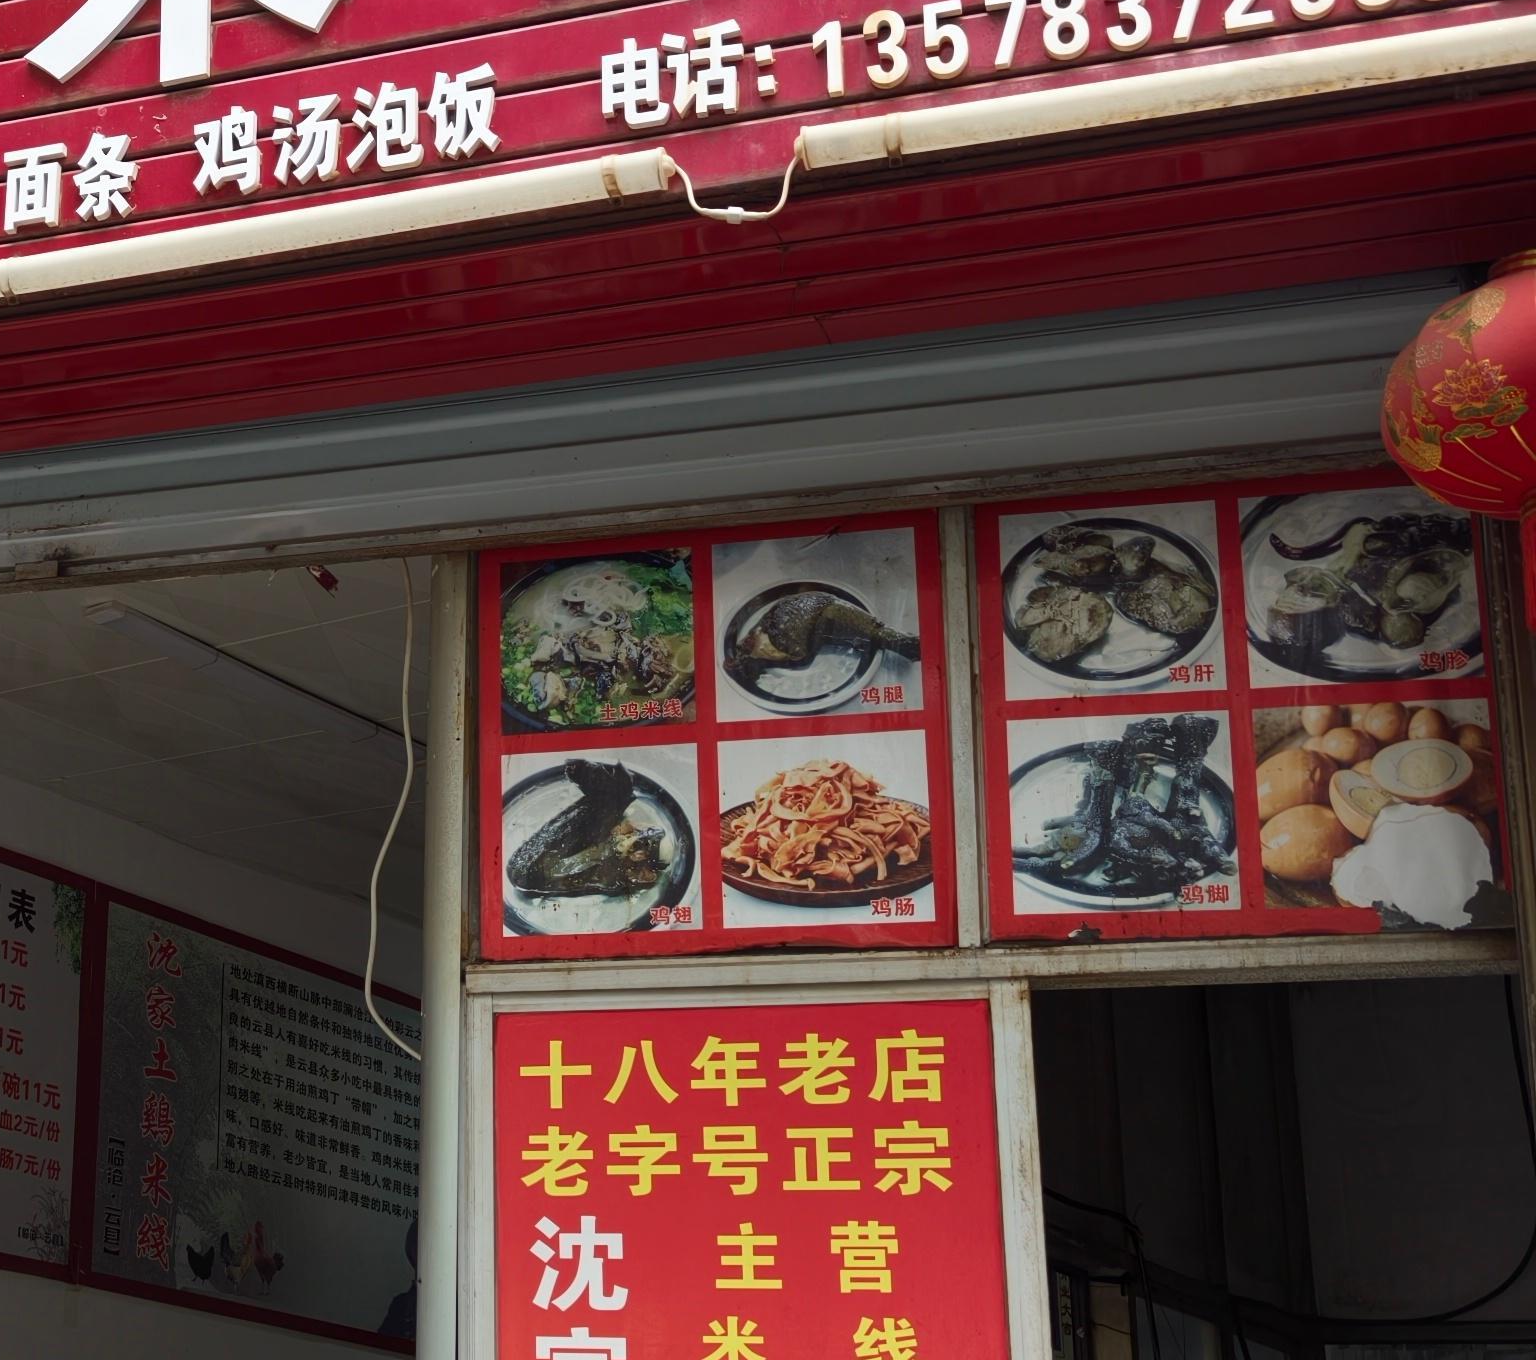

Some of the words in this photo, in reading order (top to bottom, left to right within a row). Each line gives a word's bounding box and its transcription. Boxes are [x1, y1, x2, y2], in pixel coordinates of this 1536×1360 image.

[3, 134, 139, 235] 面条
[193, 62, 501, 196] 鸡汤泡饭
[1417, 649, 1471, 672] 鸡胗
[1168, 663, 1215, 684] 鸡肝
[860, 685, 904, 706] 鸡腿
[599, 698, 683, 722] 土鸡米线
[1180, 884, 1231, 905] 鸡脚
[650, 906, 693, 925] 鸡翅
[871, 897, 916, 918] 鸡肠
[519, 1029, 945, 1109] 十八年老店
[521, 1120, 953, 1197] 老字号正宗
[715, 1220, 899, 1294] 主营
